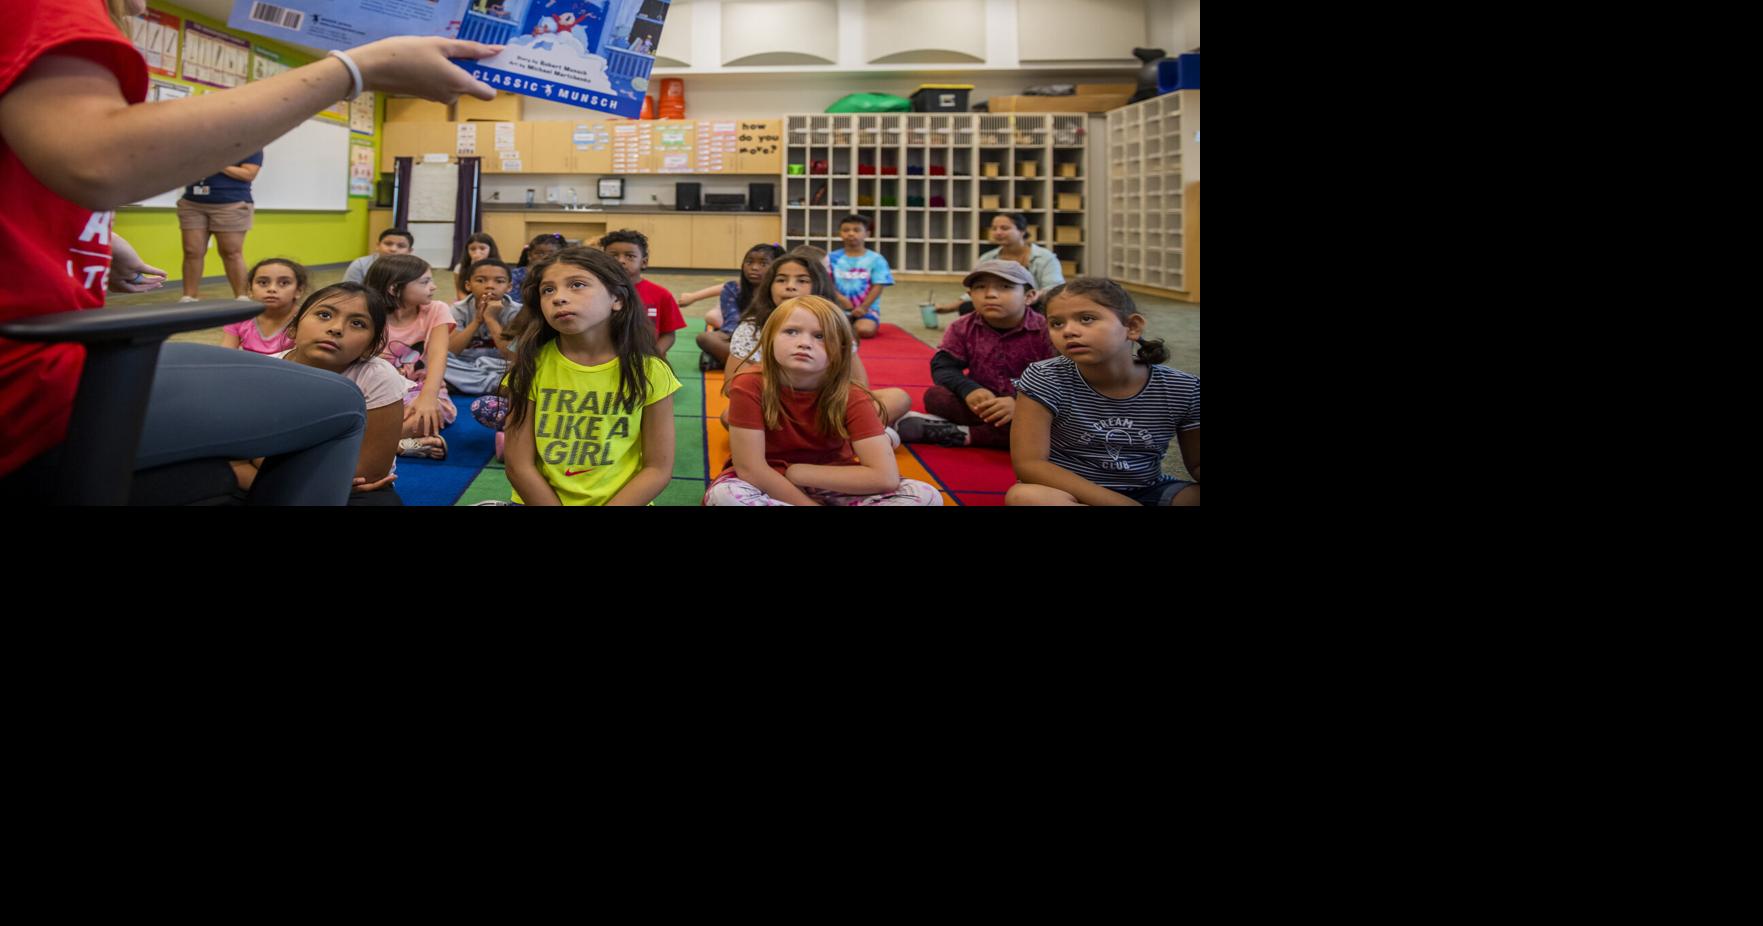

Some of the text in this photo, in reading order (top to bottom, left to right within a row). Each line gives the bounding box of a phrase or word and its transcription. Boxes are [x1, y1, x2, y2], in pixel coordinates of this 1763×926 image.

[564, 65, 588, 76] Munsch
[472, 70, 618, 110] CLASSIC MUNSCH
[742, 122, 766, 130] how
[739, 134, 779, 143] do you
[739, 145, 777, 155] move?
[540, 388, 635, 416] TRAIN
[536, 413, 629, 440] LIKE A
[1093, 417, 1134, 431] CREAM
[543, 440, 615, 466] GIRL
[1101, 460, 1131, 470] CLUB
